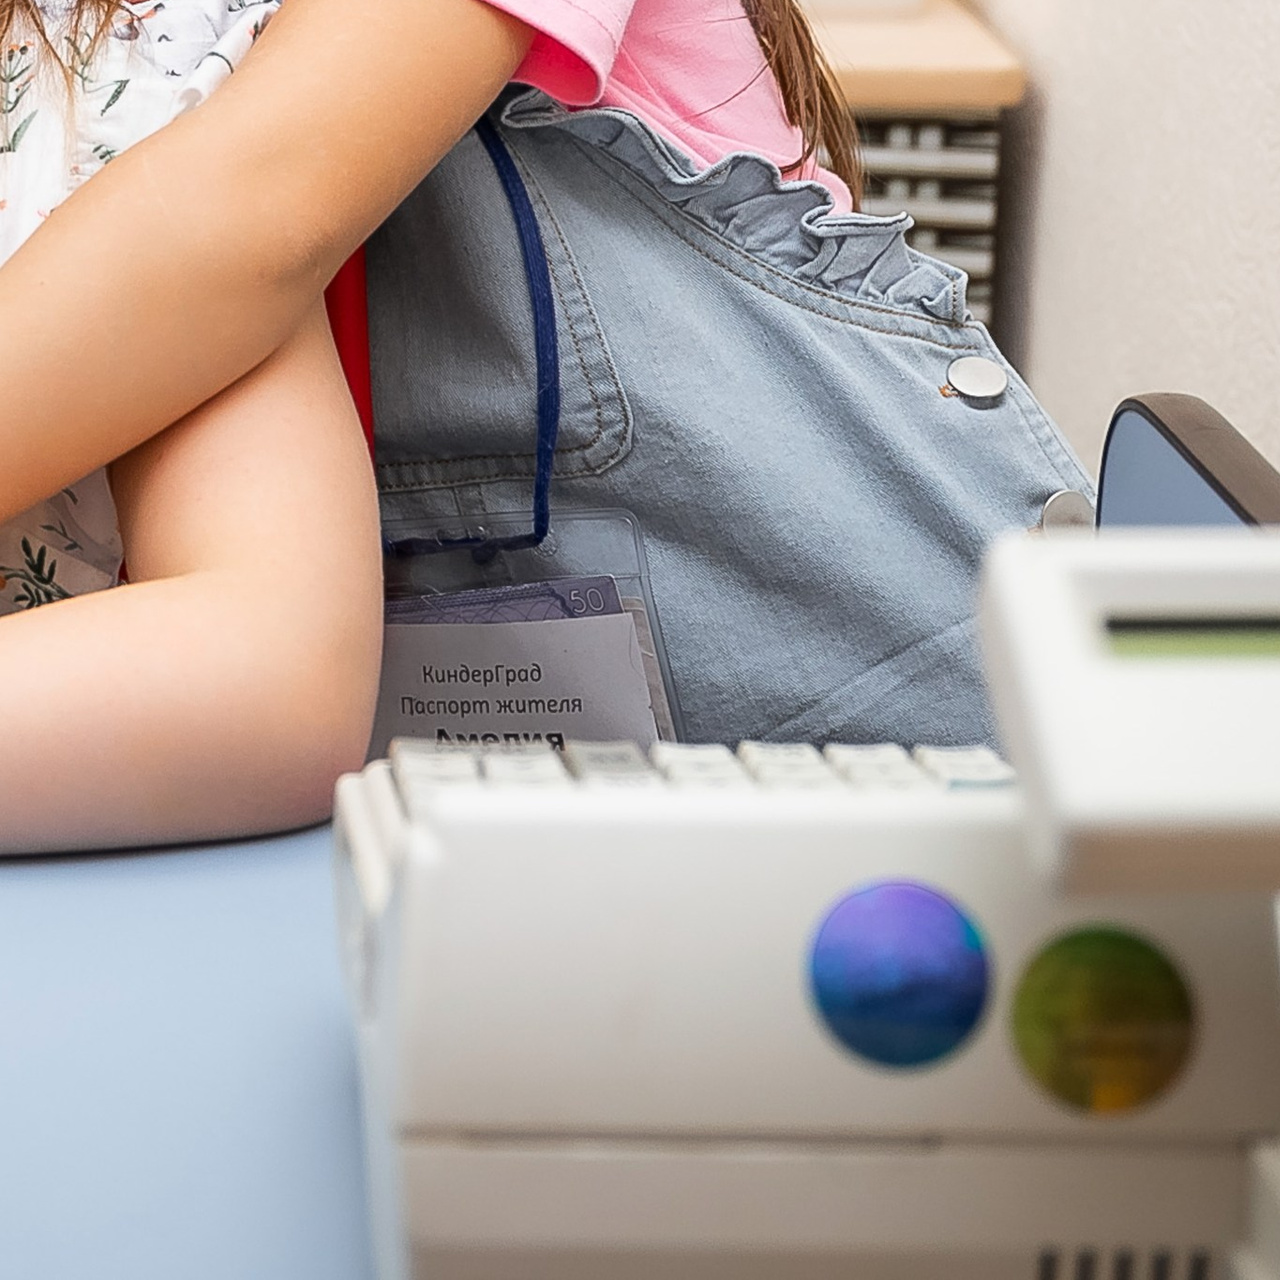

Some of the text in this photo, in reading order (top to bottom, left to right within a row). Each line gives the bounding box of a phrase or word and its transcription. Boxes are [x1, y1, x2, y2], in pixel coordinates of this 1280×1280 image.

[570, 588, 605, 614] 50
[423, 663, 542, 687] КиндерГрад
[401, 696, 583, 718] Паспорт жителя
